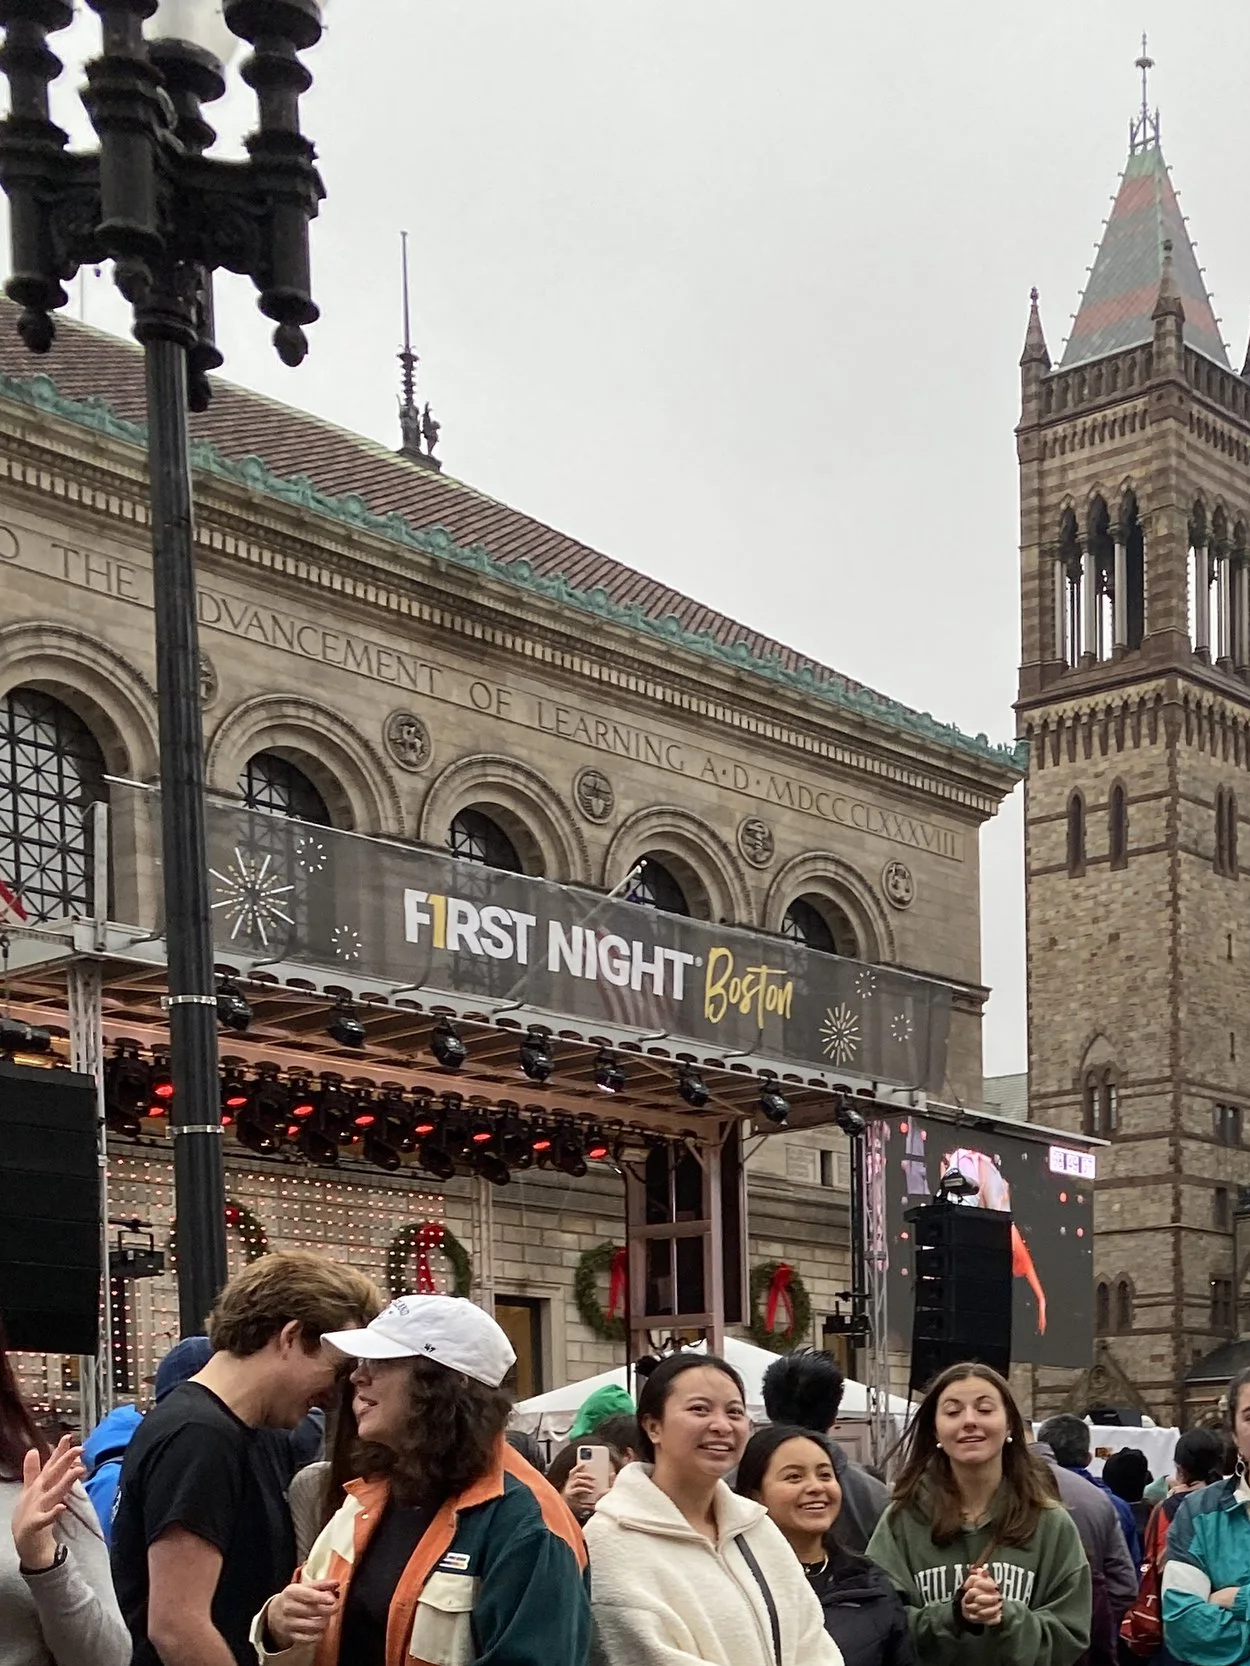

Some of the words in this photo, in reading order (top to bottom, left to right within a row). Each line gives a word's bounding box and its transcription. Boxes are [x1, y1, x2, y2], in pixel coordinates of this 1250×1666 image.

[51, 543, 139, 600] THE
[198, 590, 443, 694] DVANCEMENT
[469, 681, 512, 717] OF
[536, 700, 684, 771] LEARNING
[704, 946, 792, 1029] Boston
[914, 1562, 1035, 1606] HILAPHIA
